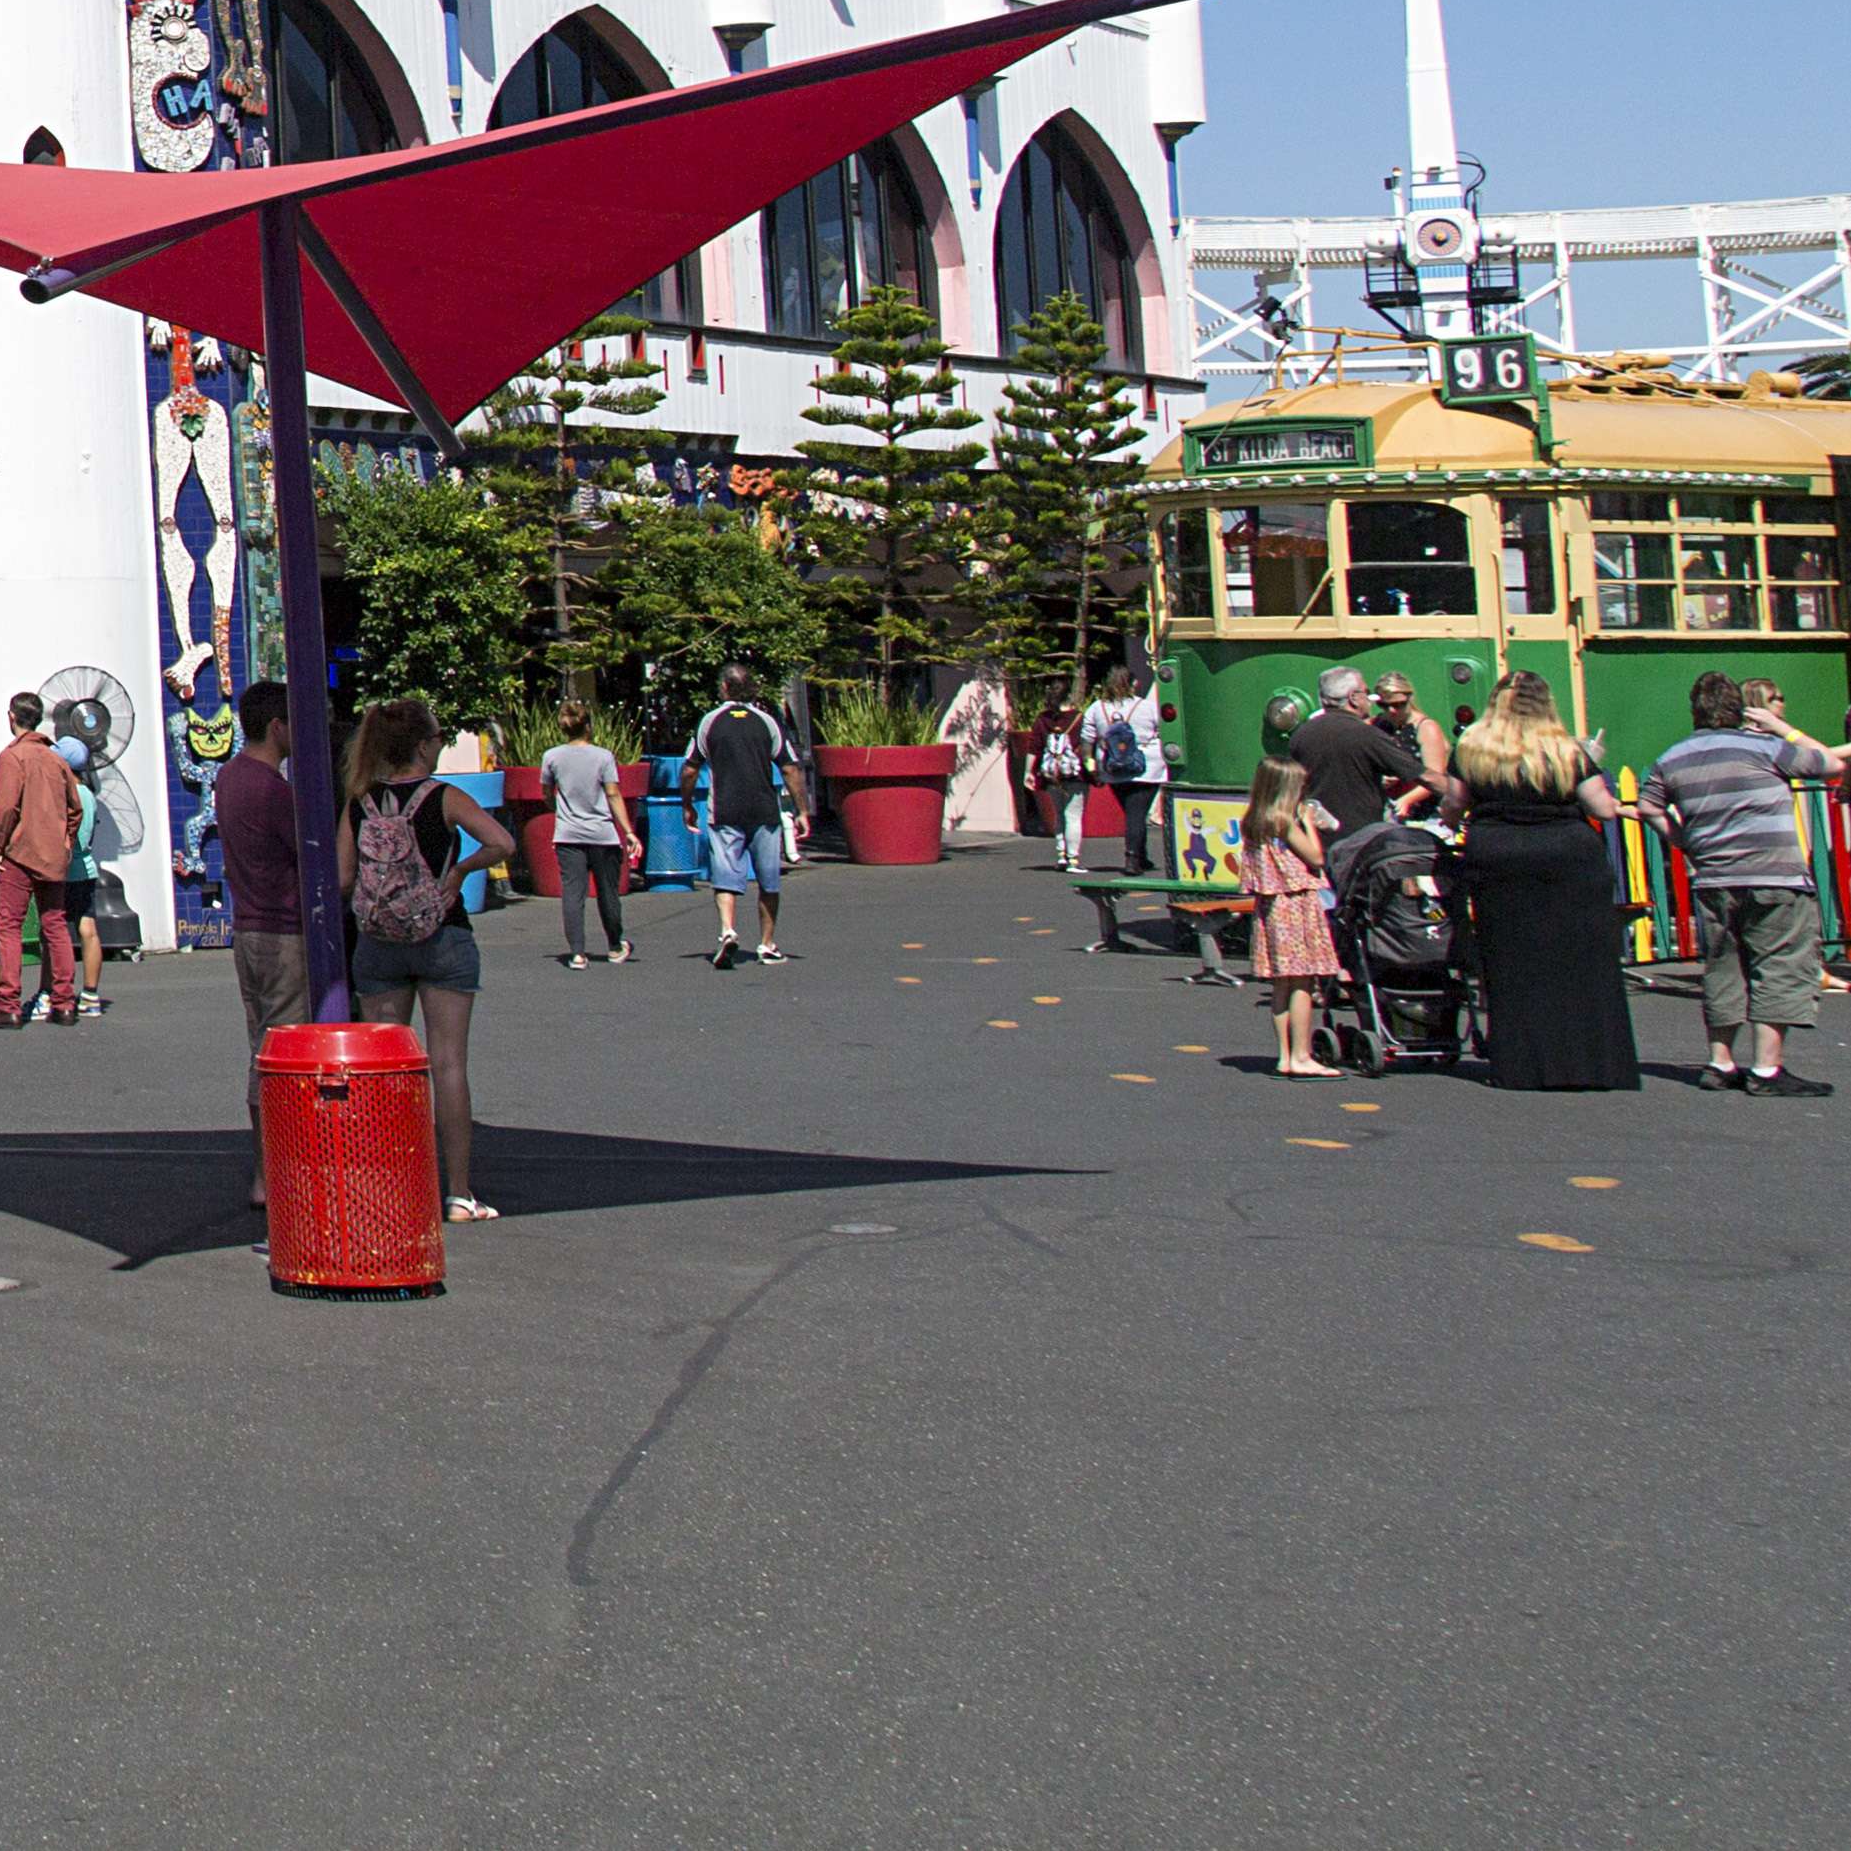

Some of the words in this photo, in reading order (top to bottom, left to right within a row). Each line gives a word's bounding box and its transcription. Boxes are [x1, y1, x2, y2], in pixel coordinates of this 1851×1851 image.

[162, 79, 213, 117] HA
[1453, 348, 1522, 389] 96
[1212, 440, 1230, 463] ST
[1237, 434, 1289, 462] KILDA
[1300, 429, 1355, 458] BEACH
